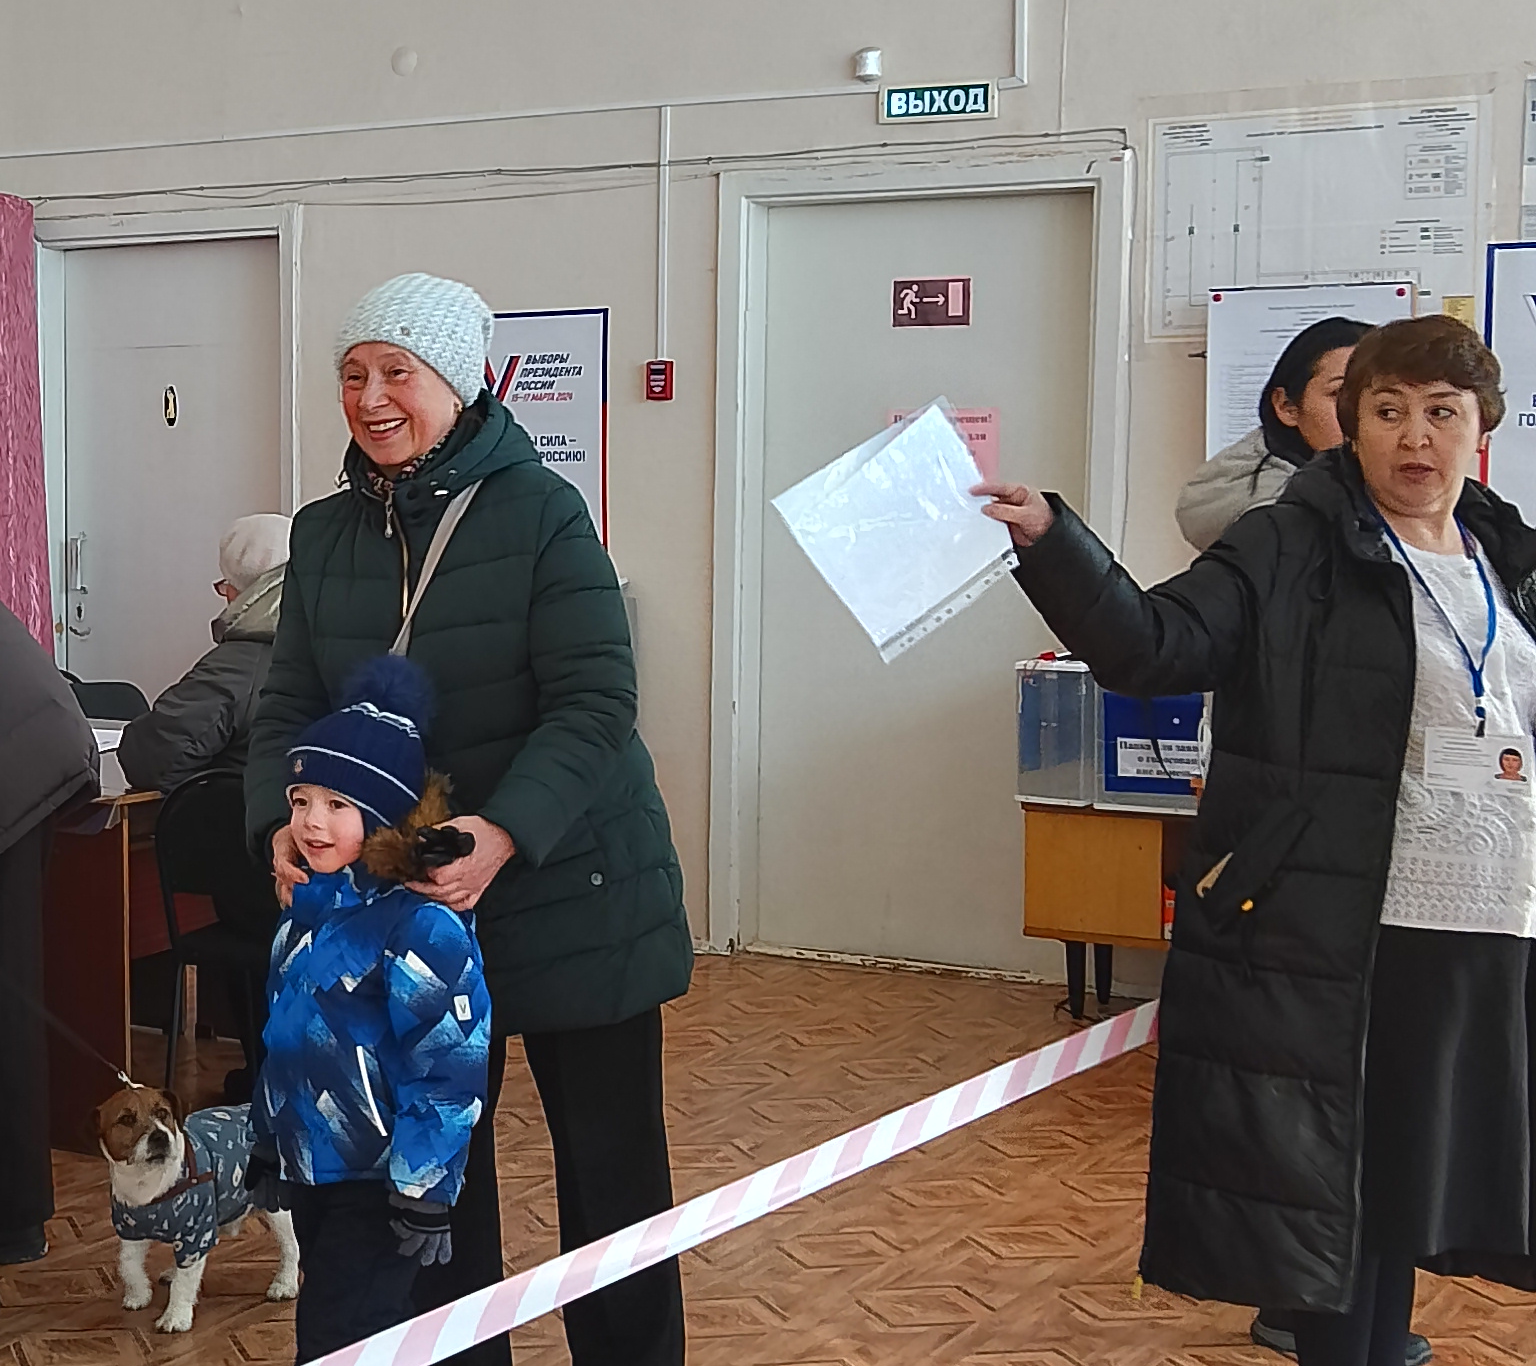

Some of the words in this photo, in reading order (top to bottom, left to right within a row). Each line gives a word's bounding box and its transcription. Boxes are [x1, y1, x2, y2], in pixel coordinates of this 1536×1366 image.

[890, 87, 985, 115] ВЫХОД
[525, 353, 570, 365] ВЫБОРЫ
[520, 366, 583, 378] ПРЕЗИДЕНТА
[515, 379, 556, 391] РОССИИ
[530, 392, 555, 402] МАРТА
[556, 392, 573, 401] 2024
[540, 435, 567, 446] СИЛА
[540, 450, 585, 462] РОССИЮ!
